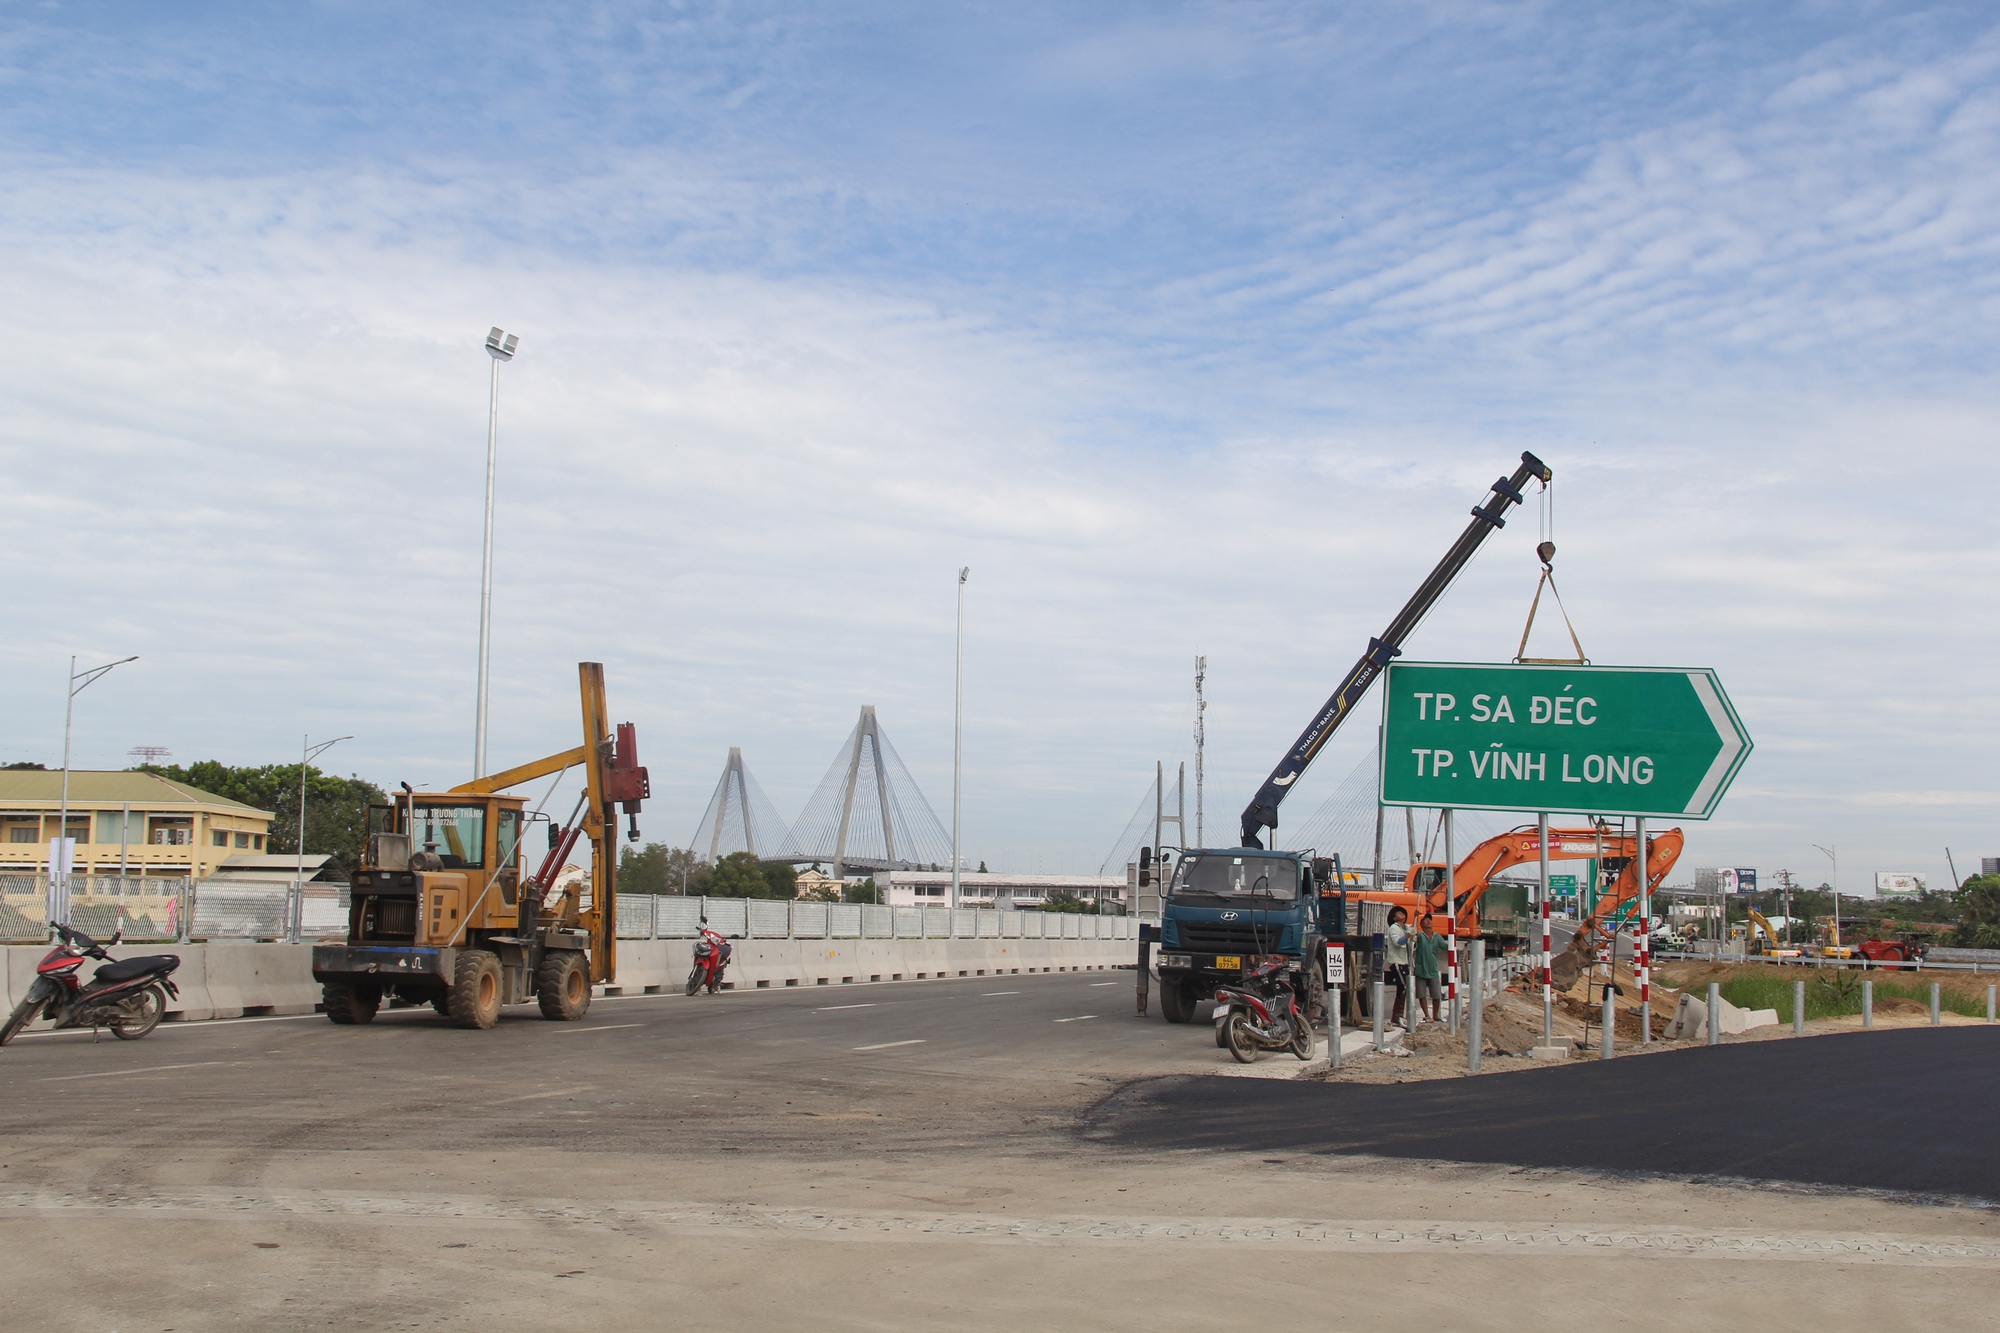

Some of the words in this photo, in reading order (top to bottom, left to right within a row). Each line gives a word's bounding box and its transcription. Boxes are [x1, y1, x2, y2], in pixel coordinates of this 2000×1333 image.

[1355, 667, 1373, 687] TC304
[1414, 692, 1460, 721] TP.
[1470, 694, 1515, 723] SA
[1529, 684, 1597, 725] ĐÉC
[1299, 730, 1318, 752] THACO
[1411, 748, 1458, 778] TP.
[1469, 742, 1546, 781] VĨNH
[1561, 753, 1654, 785] LONG
[1329, 954, 1342, 964] H4
[1329, 969, 1342, 977] 107
